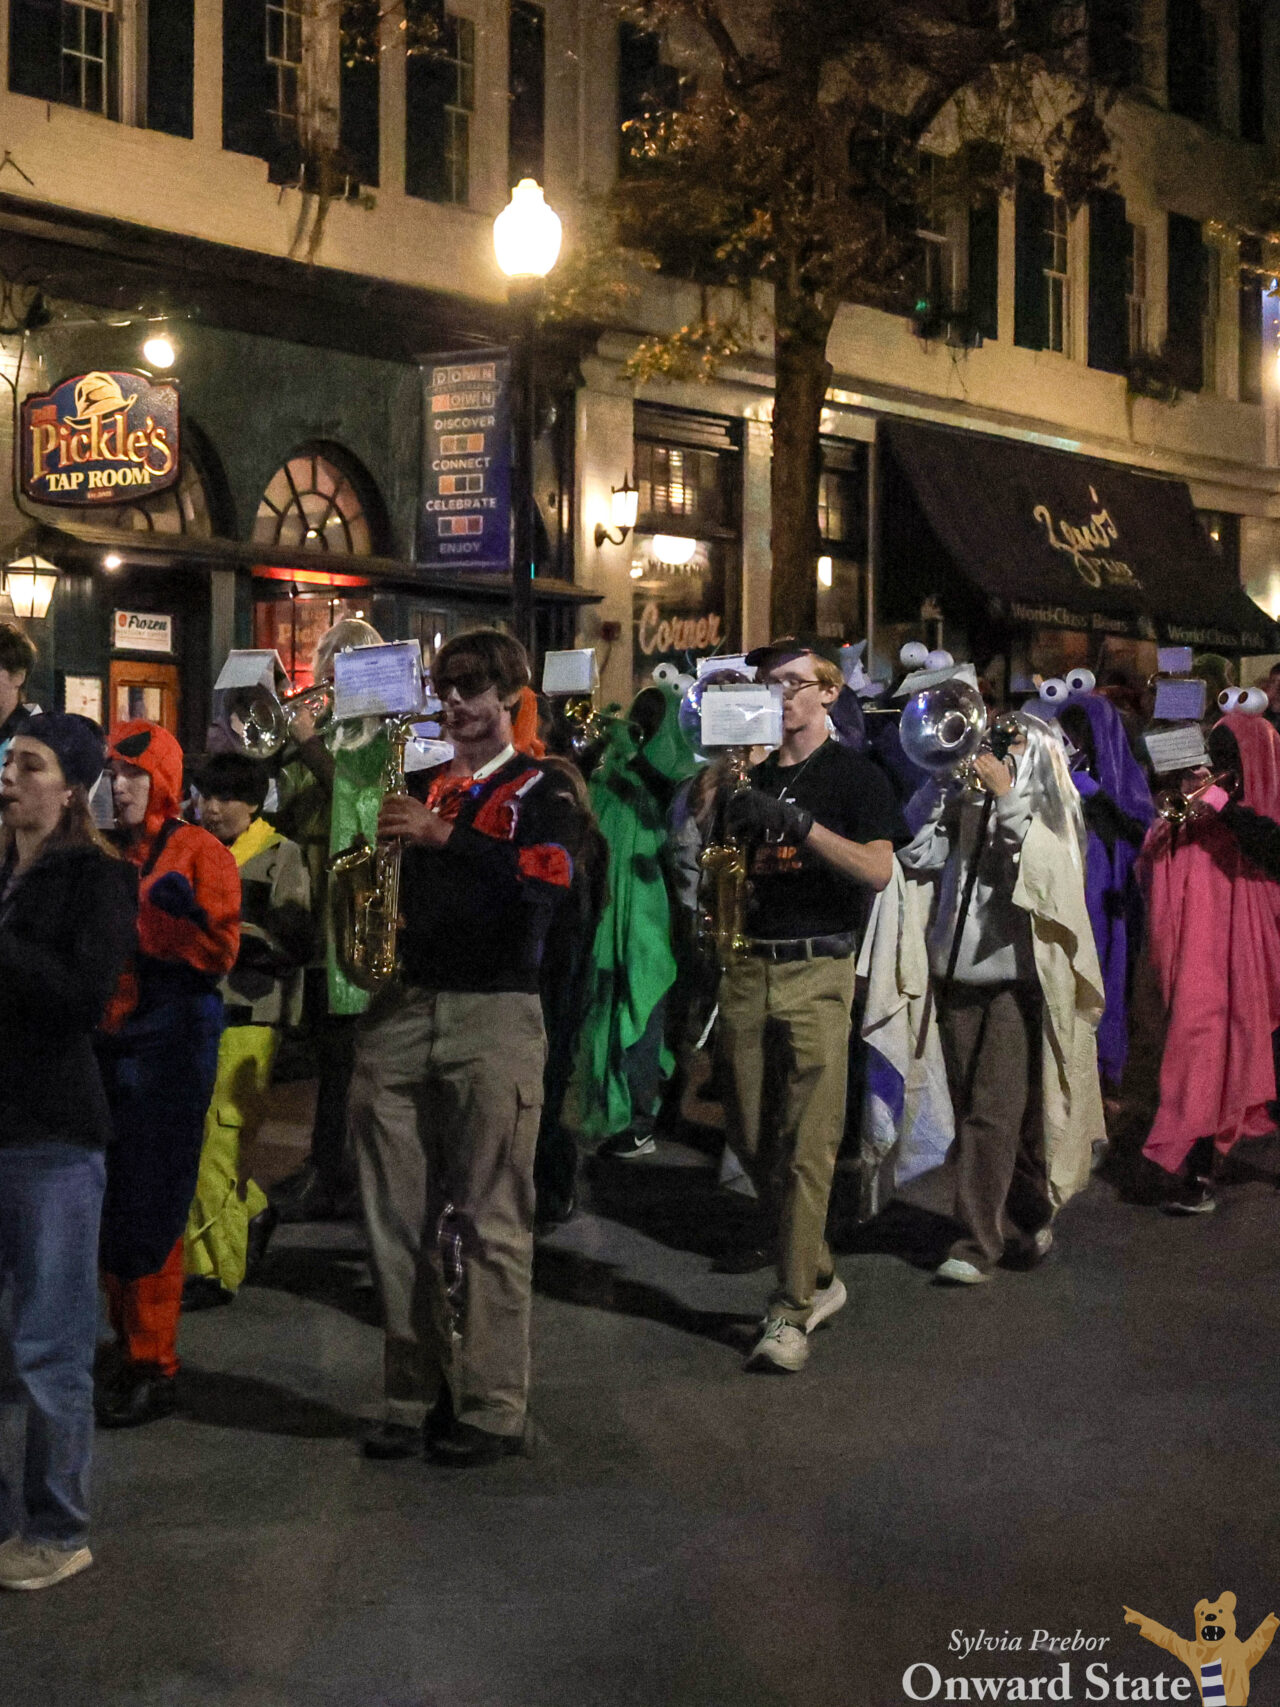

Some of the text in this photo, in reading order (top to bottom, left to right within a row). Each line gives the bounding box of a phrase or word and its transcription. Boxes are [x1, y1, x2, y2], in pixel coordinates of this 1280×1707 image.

[435, 393, 493, 408] OWN
[433, 415, 496, 431] DISCOVER
[28, 411, 173, 483] Pickle's
[432, 457, 492, 471] CONNECT
[46, 467, 152, 492] TAP ROOM
[425, 497, 498, 512] CELEBRATE
[439, 541, 482, 555] ENJOY
[128, 615, 168, 631] Frozen
[638, 602, 721, 656] Corner
